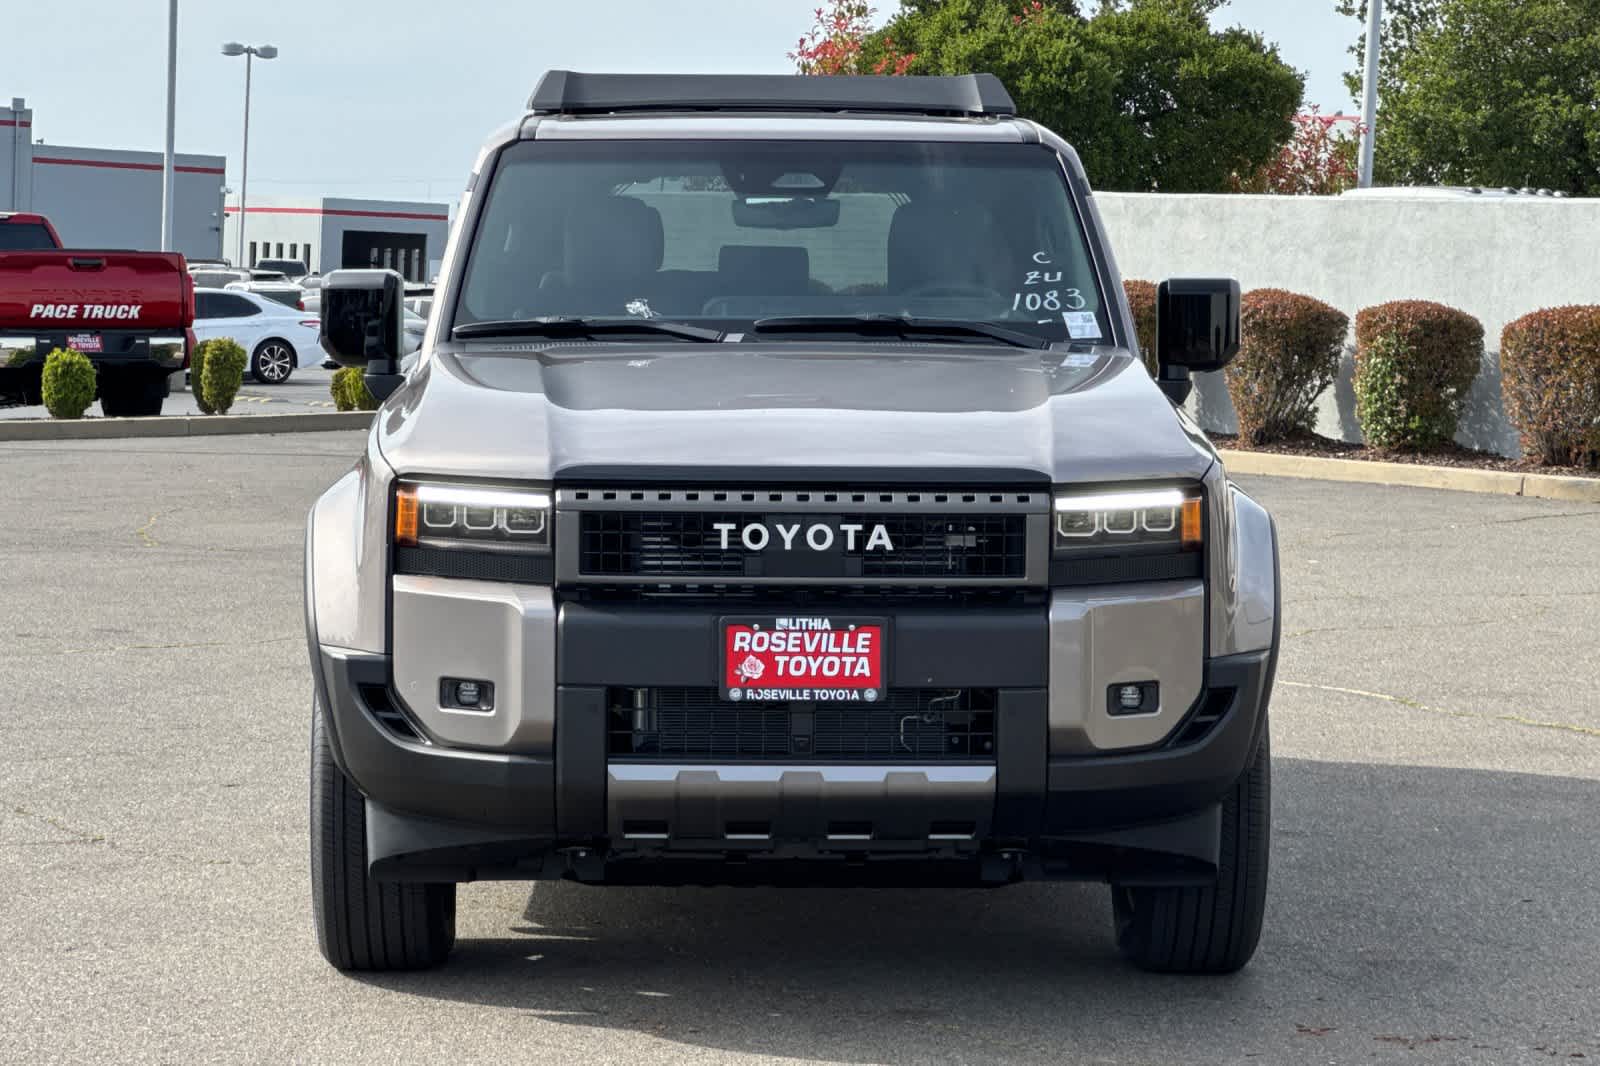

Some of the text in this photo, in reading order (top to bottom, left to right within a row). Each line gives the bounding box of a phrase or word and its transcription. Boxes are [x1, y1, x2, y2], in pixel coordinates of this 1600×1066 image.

[1032, 251, 1052, 264] C
[1012, 288, 1086, 311] 1083
[30, 304, 142, 319] PACE TRUCK
[712, 523, 894, 551] TOYOTA
[788, 618, 831, 630] LITHIA
[733, 632, 872, 653] ROSEVILLE
[774, 656, 871, 677] TOYOTA
[746, 689, 859, 700] ROSEVILLE TOYOTA
